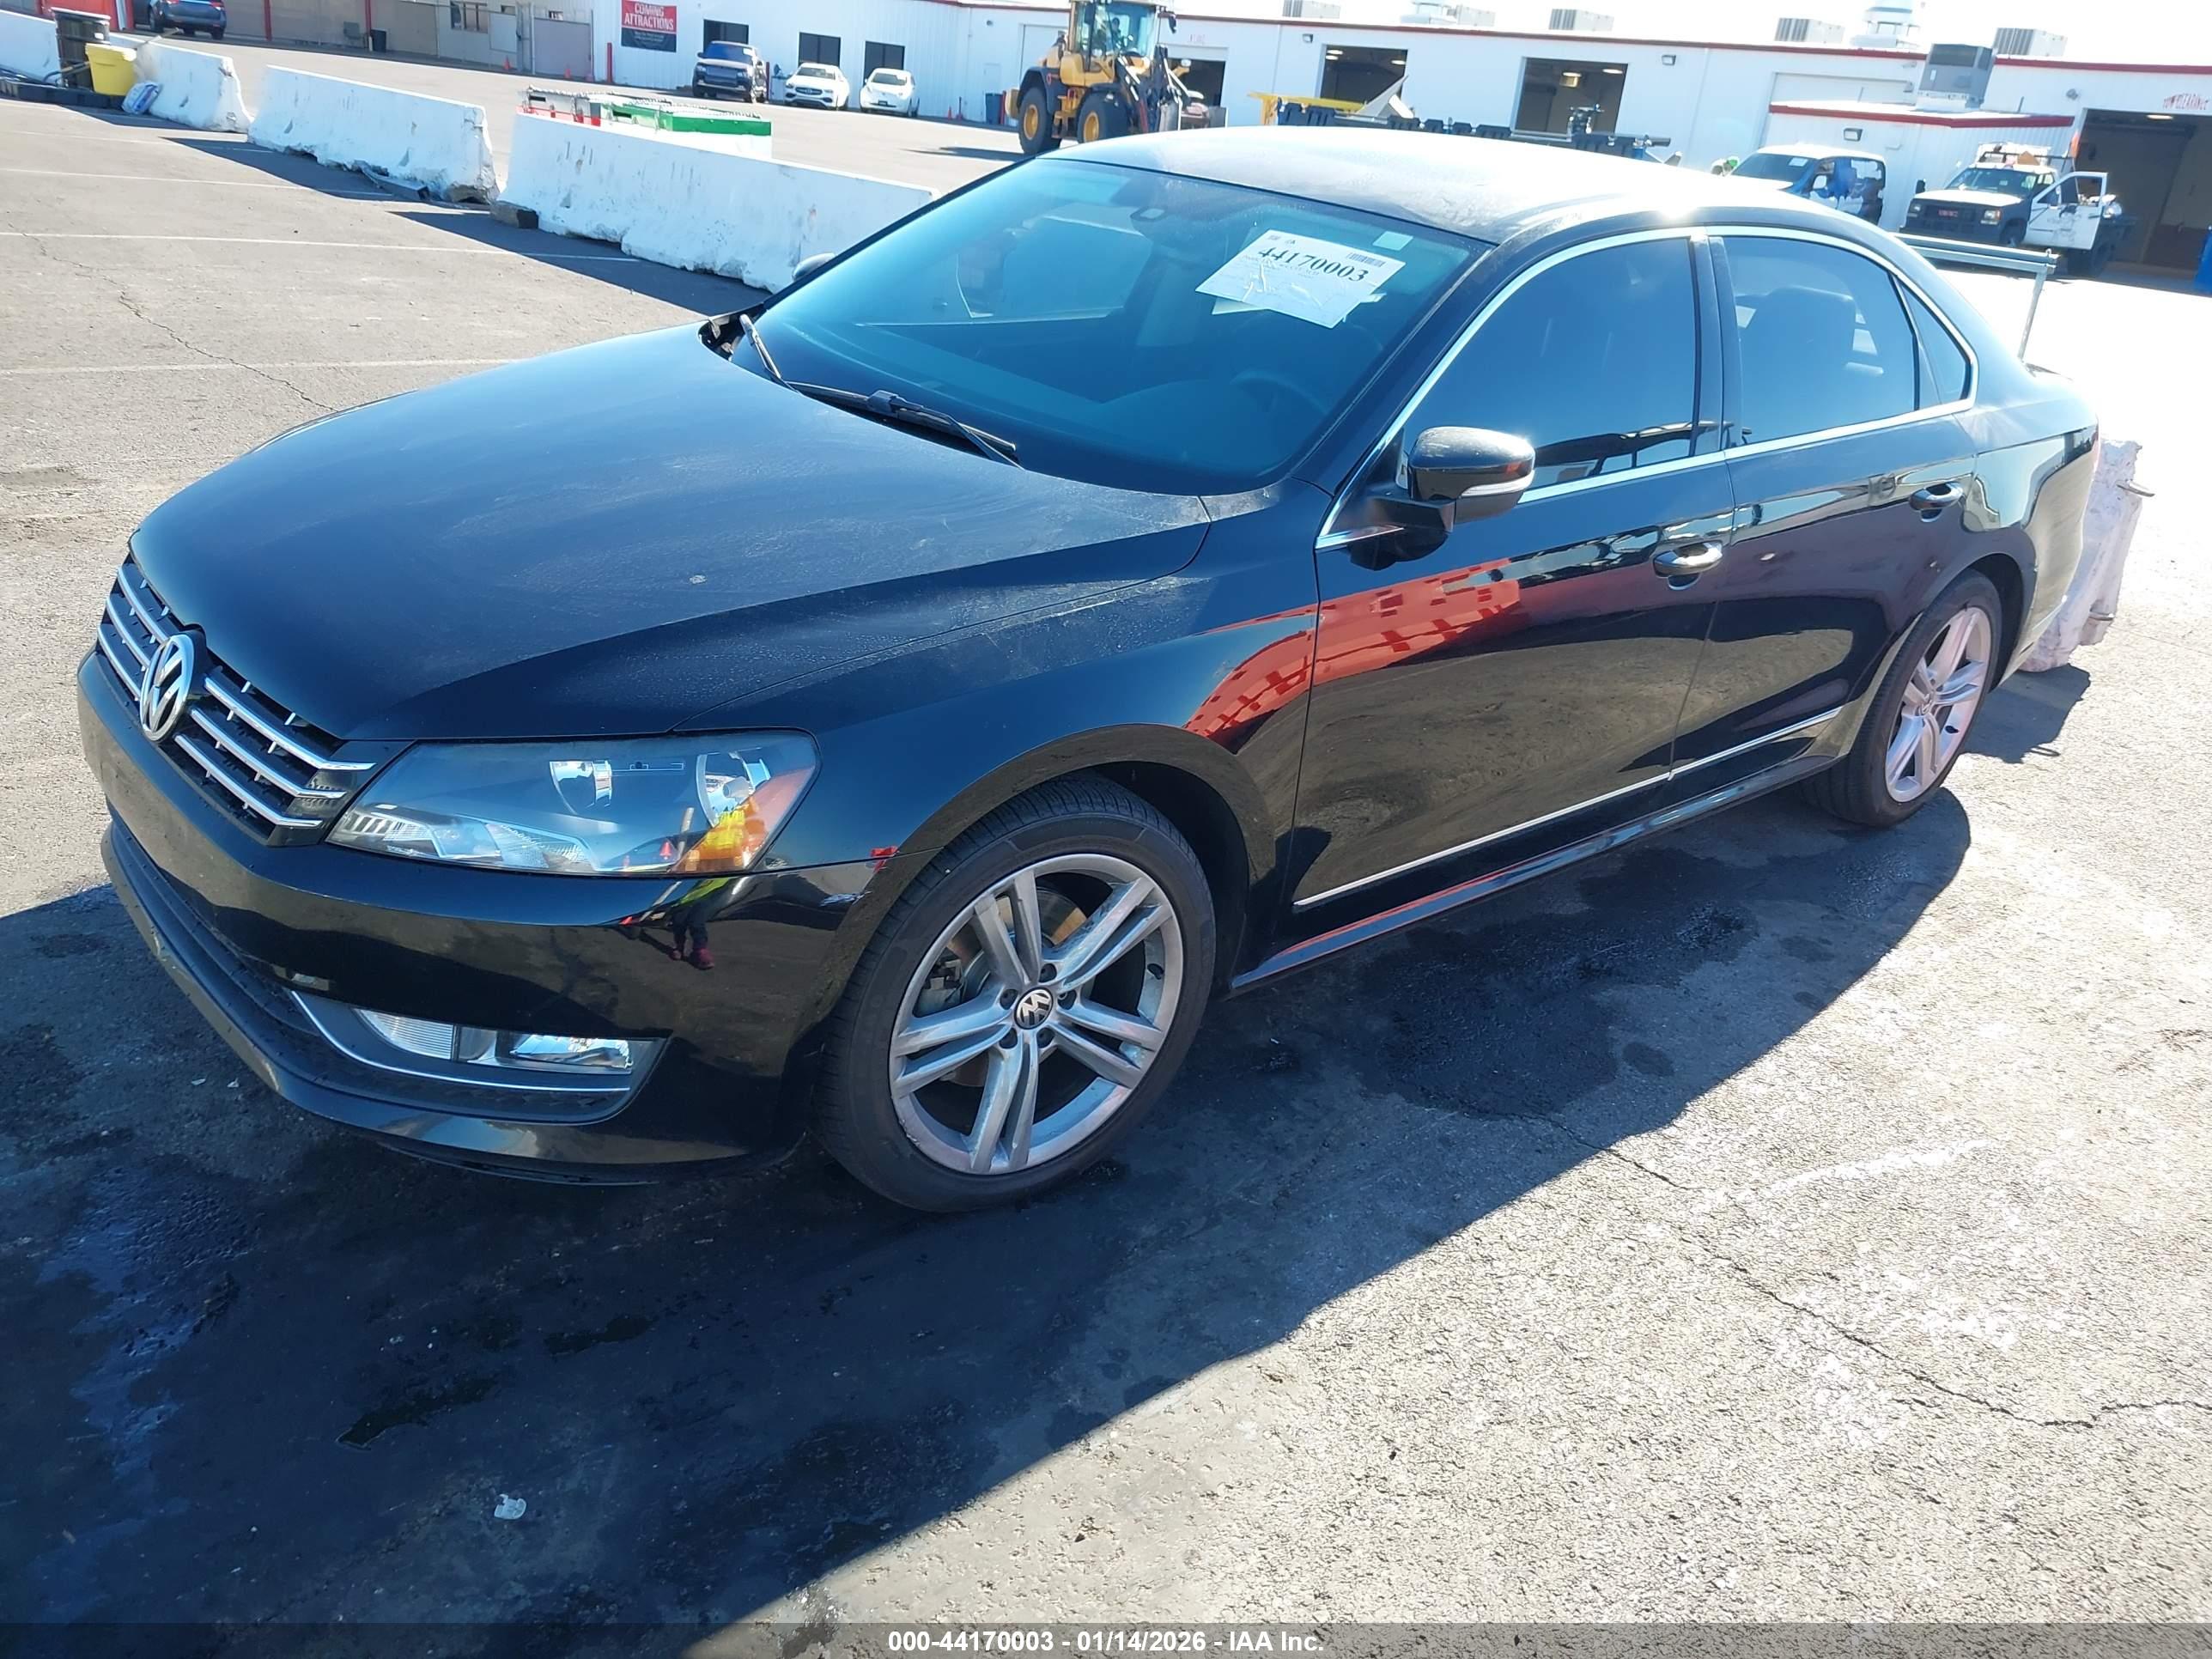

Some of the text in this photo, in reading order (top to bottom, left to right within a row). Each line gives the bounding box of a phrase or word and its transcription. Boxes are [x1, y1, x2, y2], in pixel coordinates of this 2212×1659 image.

[634, 3, 665, 17] COMING
[624, 12, 675, 30] ATTRACTIONS
[1258, 246, 1369, 282] 44170003
